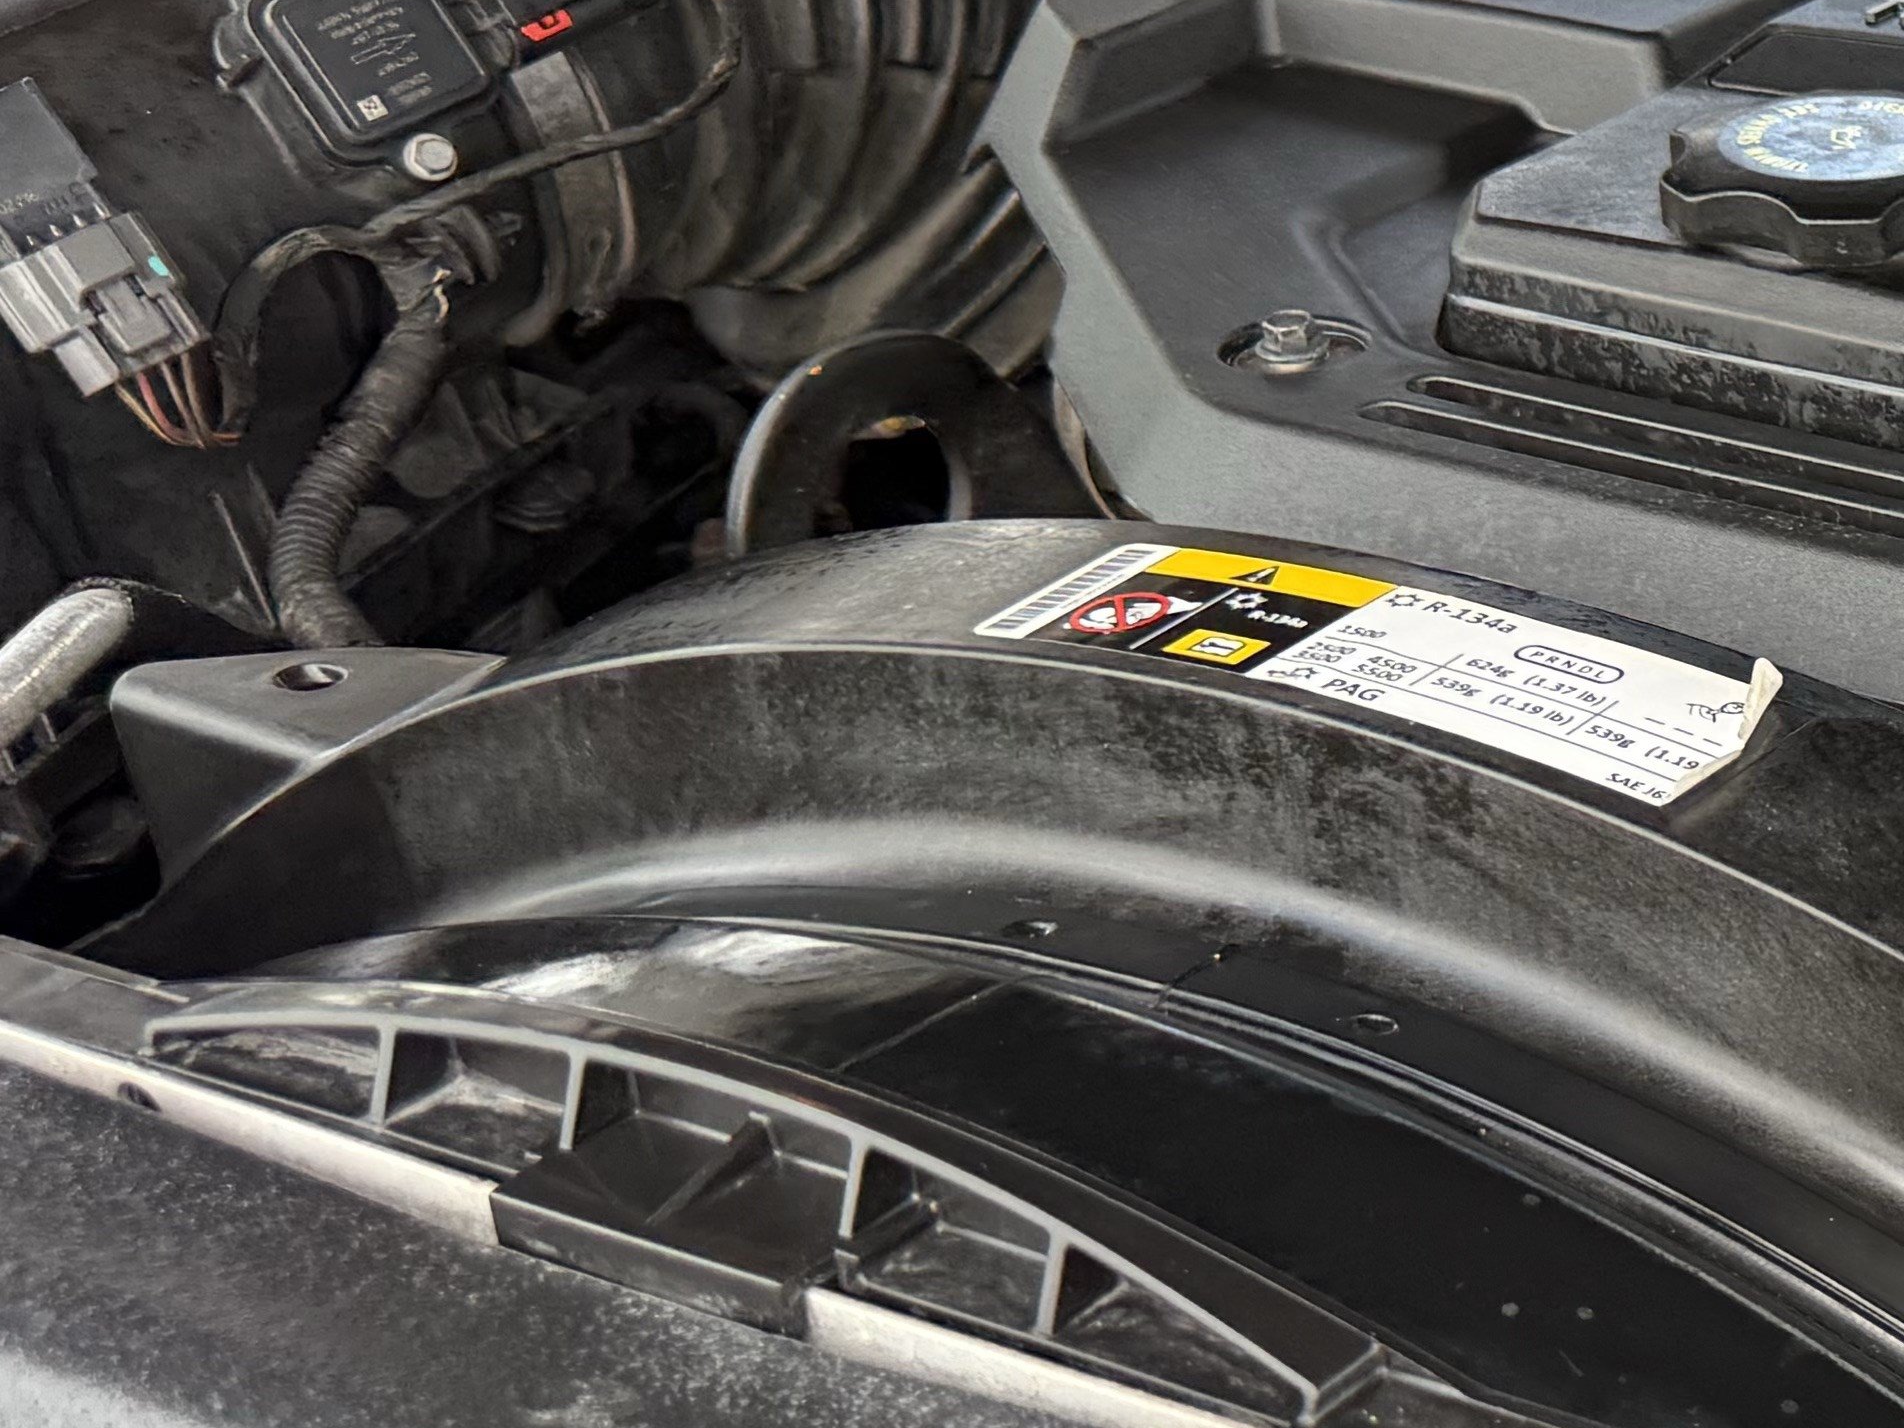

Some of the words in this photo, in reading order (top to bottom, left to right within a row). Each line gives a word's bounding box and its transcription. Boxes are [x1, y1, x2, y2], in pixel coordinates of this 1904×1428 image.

[1423, 601, 1519, 634] R-134a
[1336, 624, 1388, 639] 1500
[1464, 658, 1515, 680] 624g
[1522, 674, 1575, 696] (1.37
[1576, 688, 1607, 708] lb)
[1351, 663, 1403, 682] 5500
[1321, 678, 1387, 703] PAG
[1367, 655, 1418, 673] 4500
[1430, 676, 1482, 698] 539g
[1489, 693, 1544, 716] (1.19
[1543, 708, 1575, 728] lb)
[1584, 724, 1636, 750] 539g
[1605, 771, 1645, 791] SAE
